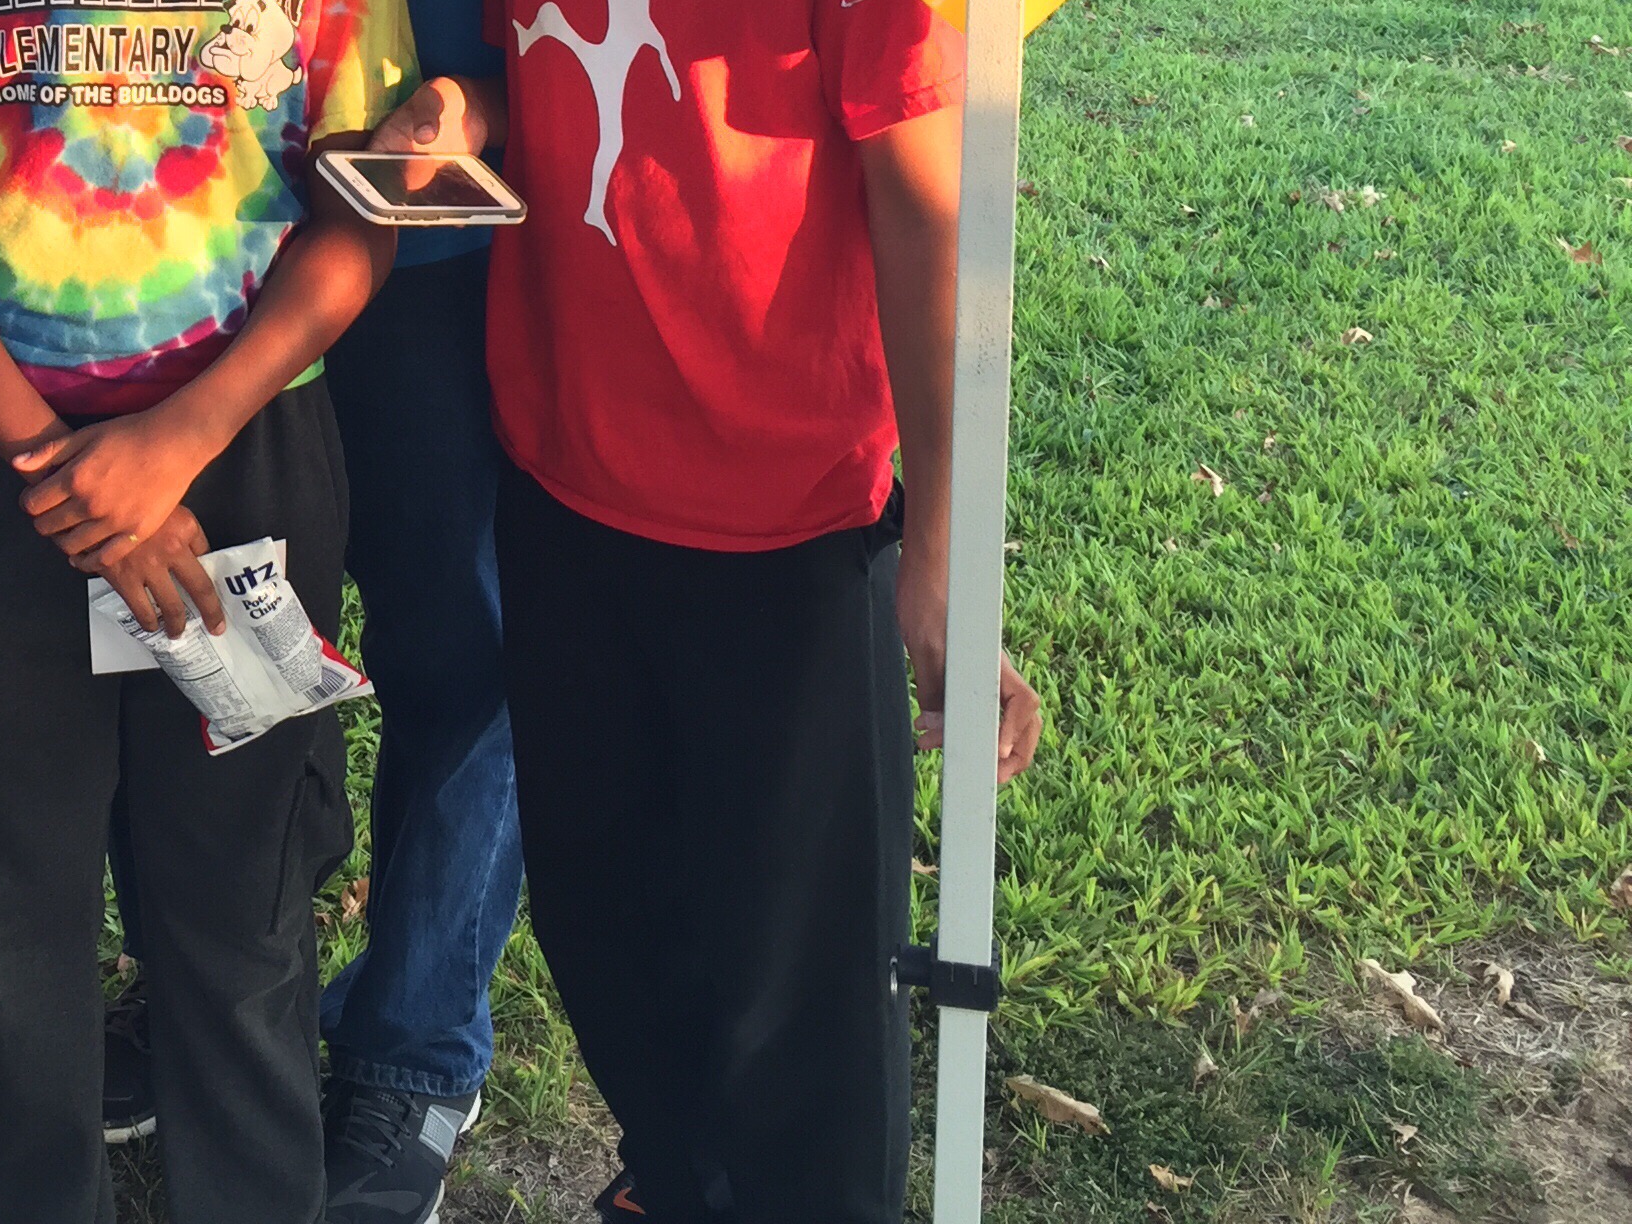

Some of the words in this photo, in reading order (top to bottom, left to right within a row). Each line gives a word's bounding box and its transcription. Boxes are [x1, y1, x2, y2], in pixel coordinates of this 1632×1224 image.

[39, 85, 67, 104] OF
[70, 85, 113, 105] THE
[118, 85, 226, 105] BULLDOGS
